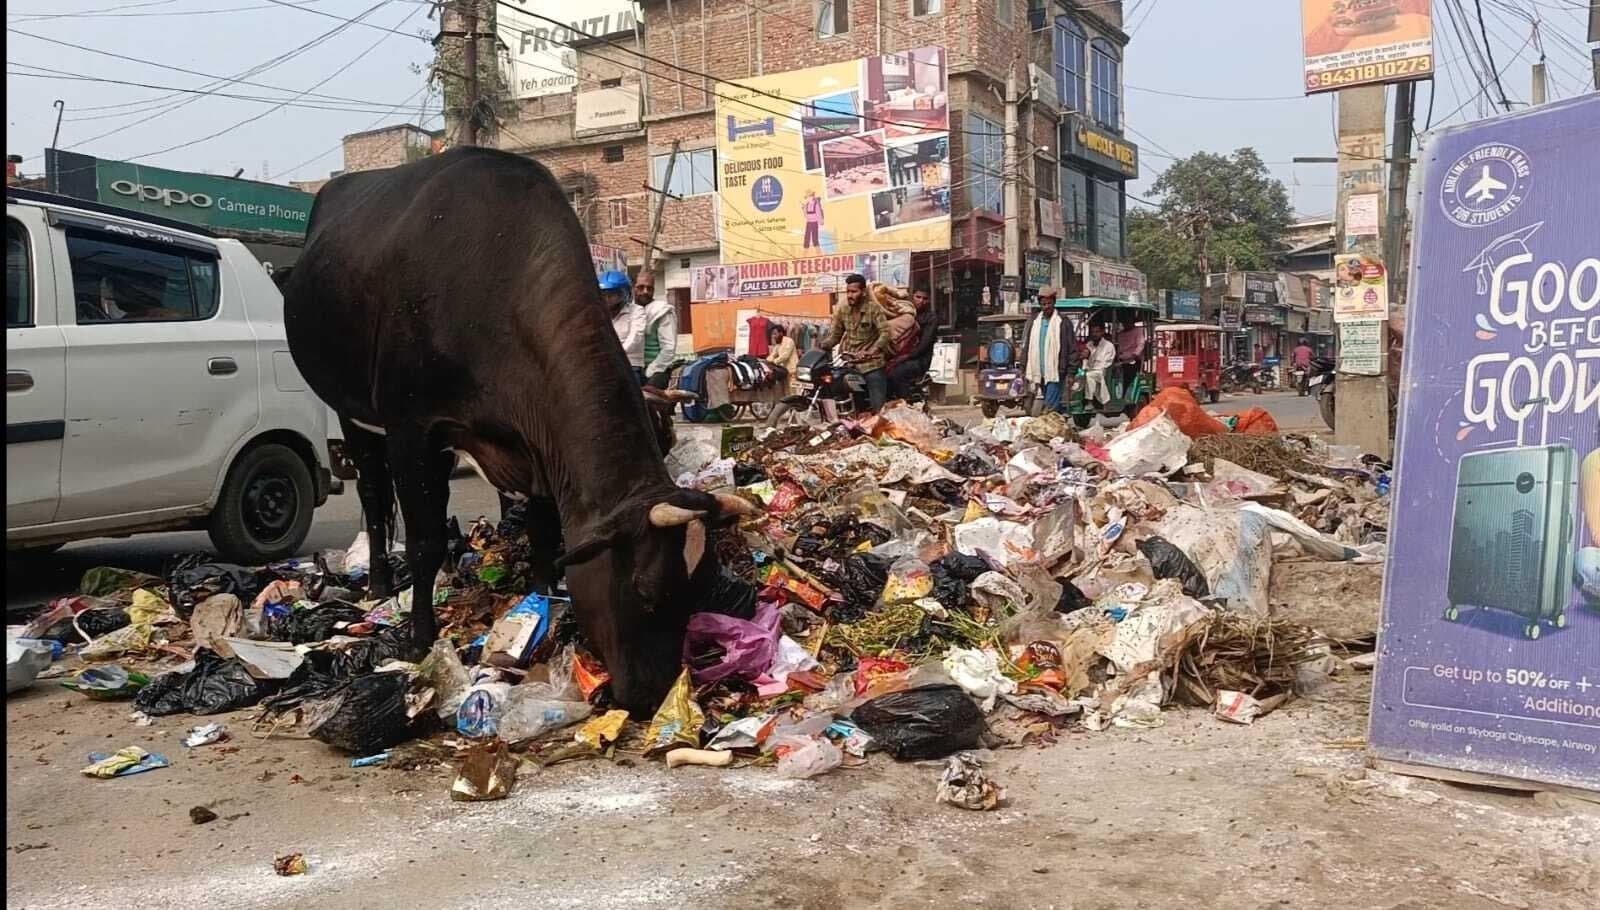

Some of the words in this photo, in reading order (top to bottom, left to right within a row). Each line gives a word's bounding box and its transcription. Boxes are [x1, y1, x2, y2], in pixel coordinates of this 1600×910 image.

[520, 77, 537, 91] Yeh
[541, 75, 575, 88] aaram
[1320, 56, 1430, 86] 9431810273
[724, 159, 761, 175] DELICIOUS
[763, 156, 783, 170] FOOD
[724, 174, 747, 188] TASTE
[217, 196, 265, 216] Camera
[268, 203, 307, 222] Phone
[1451, 206, 1470, 222] FOR
[1470, 194, 1521, 223] STUDENTS
[740, 261, 788, 280] KUMAR
[793, 255, 854, 275] TELECOM
[743, 281, 761, 291] SALE
[769, 279, 799, 289] SERVICE
[1433, 664, 1458, 679] Get
[1463, 670, 1482, 684] up
[1487, 671, 1501, 682] to
[1505, 668, 1546, 688] 50%
[1549, 679, 1570, 690] OFF
[1408, 718, 1429, 729] Offer
[1432, 722, 1452, 732] valid
[1454, 726, 1465, 734] on
[1467, 726, 1507, 742] Skybags
[1508, 732, 1560, 748] Cityscape,
[1562, 739, 1597, 754] Airway
